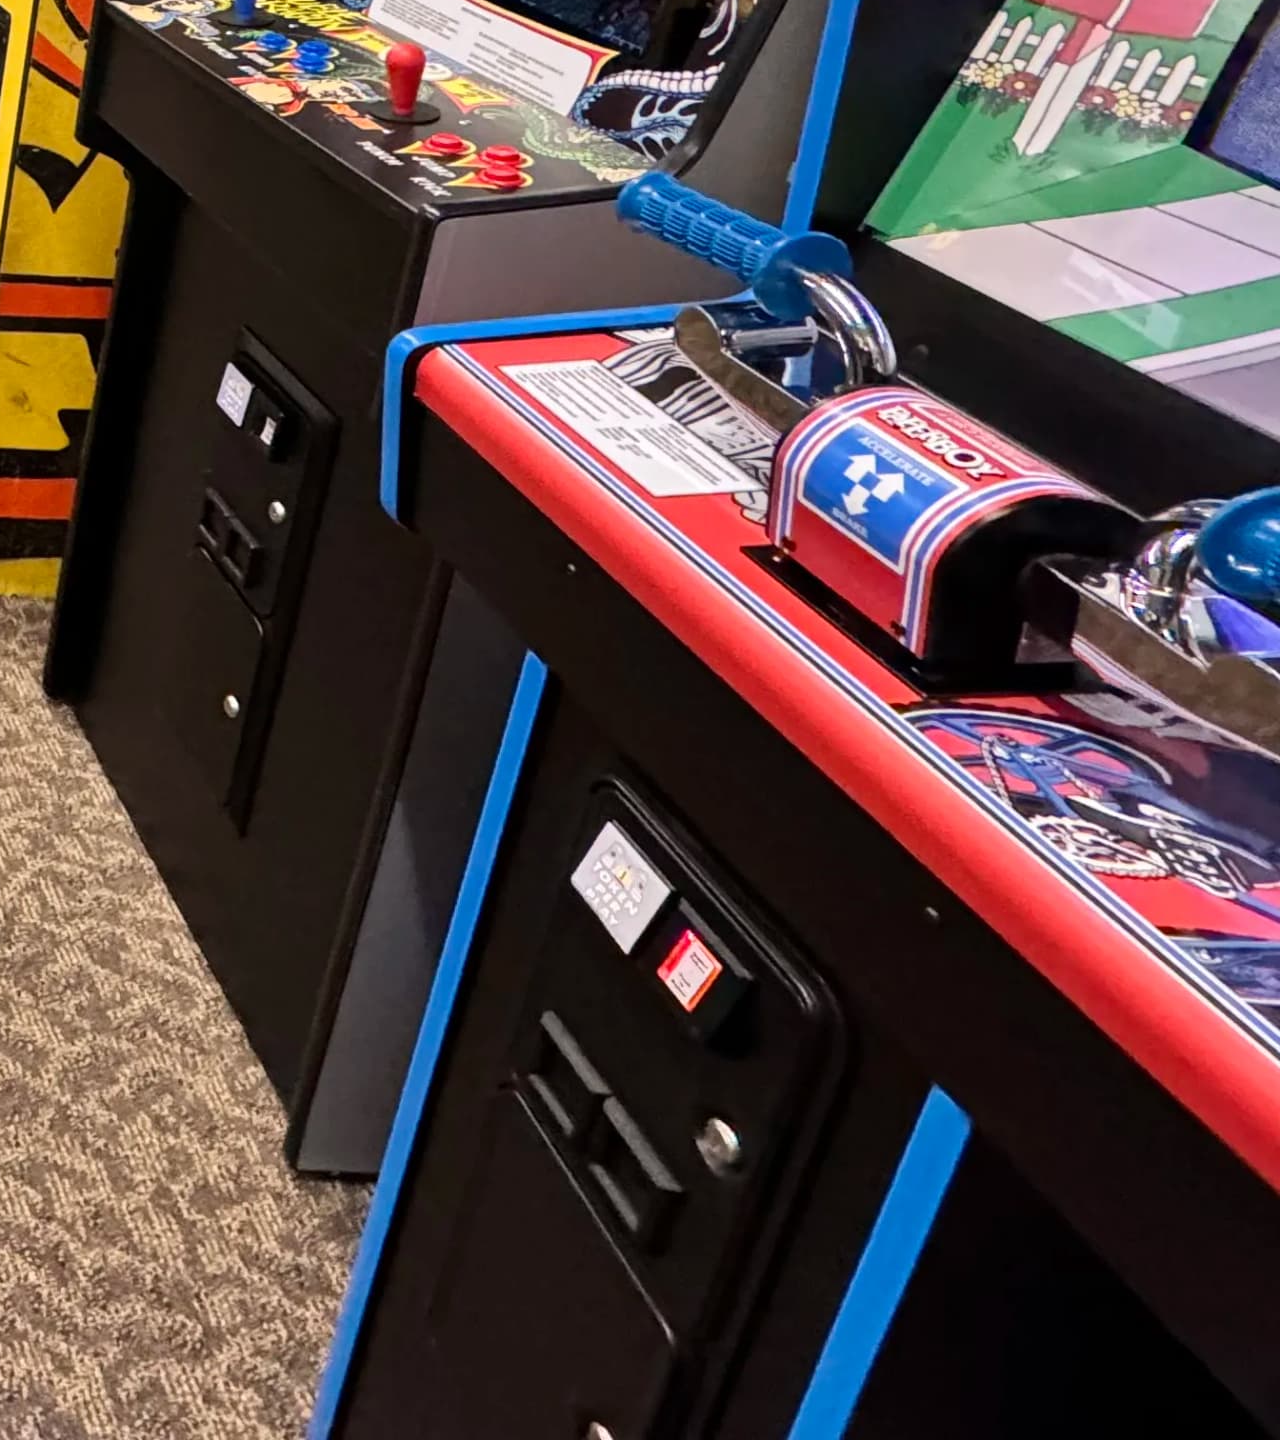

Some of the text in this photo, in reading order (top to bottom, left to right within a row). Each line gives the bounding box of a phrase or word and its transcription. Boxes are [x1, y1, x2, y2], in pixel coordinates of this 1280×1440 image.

[859, 436, 937, 487] ACCELERATE
[878, 405, 1007, 481] PAPERBOY
[586, 887, 620, 927] PLAY
[593, 861, 639, 917] TOKEN
[595, 882, 622, 913] PER
